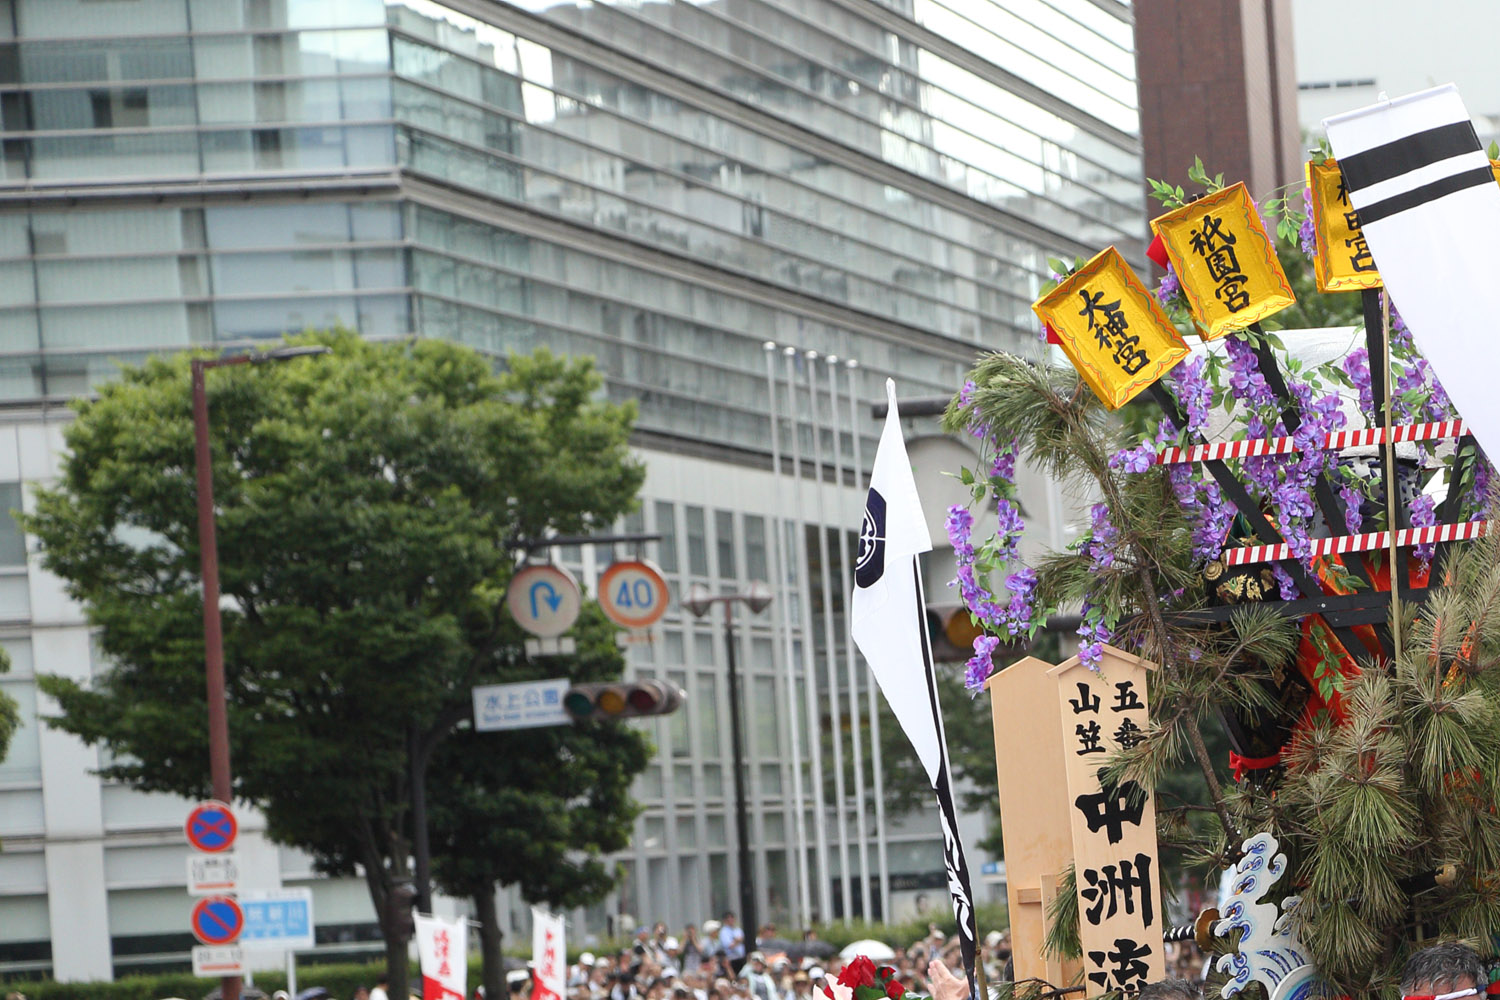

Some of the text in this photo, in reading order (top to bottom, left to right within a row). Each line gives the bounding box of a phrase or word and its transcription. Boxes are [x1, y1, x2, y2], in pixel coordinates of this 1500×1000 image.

[1078, 289, 1150, 375] 大神宮
[616, 578, 652, 608] 40
